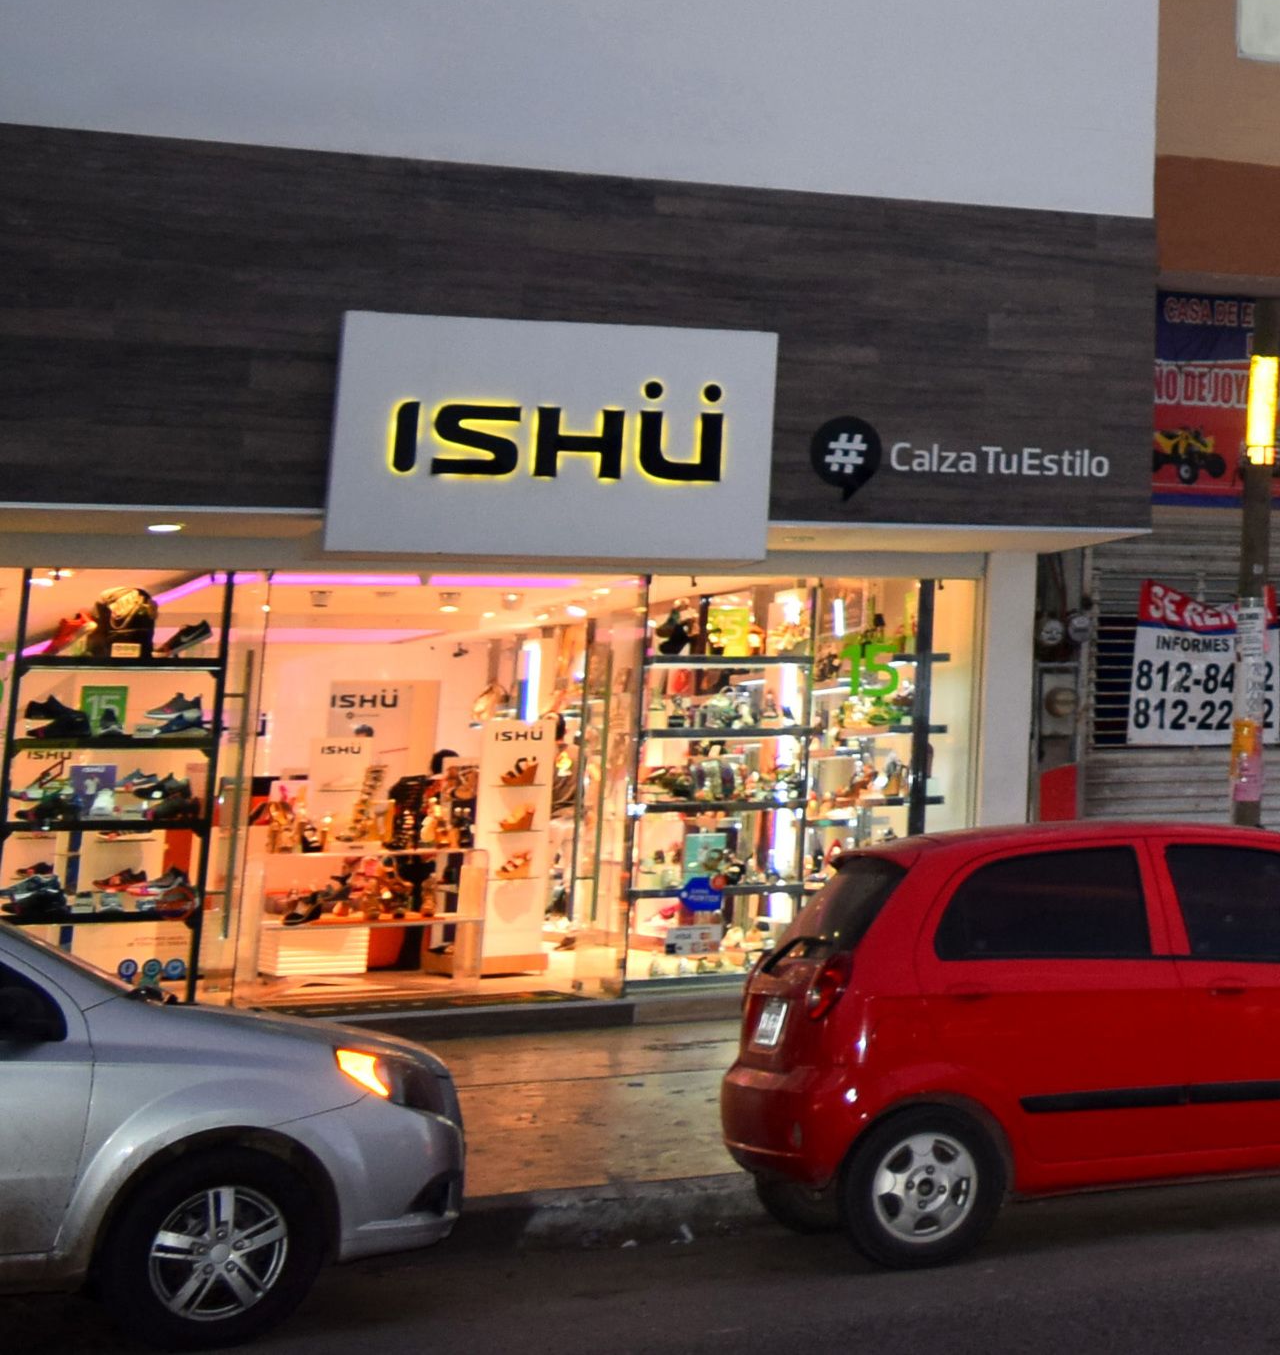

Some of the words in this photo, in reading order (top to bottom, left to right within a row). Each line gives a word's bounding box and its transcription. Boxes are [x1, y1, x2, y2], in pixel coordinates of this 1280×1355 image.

[1163, 296, 1212, 325] CASA
[1213, 299, 1238, 326] DE
[1181, 366, 1210, 406] DE
[389, 380, 726, 483] ISHÜ
[1148, 584, 1182, 622] SE
[1156, 635, 1230, 652] INFORMES
[839, 644, 899, 697] 15
[1135, 659, 1274, 694] 812-842
[329, 688, 399, 709] ISHÜ
[1133, 697, 1274, 731] 812-222
